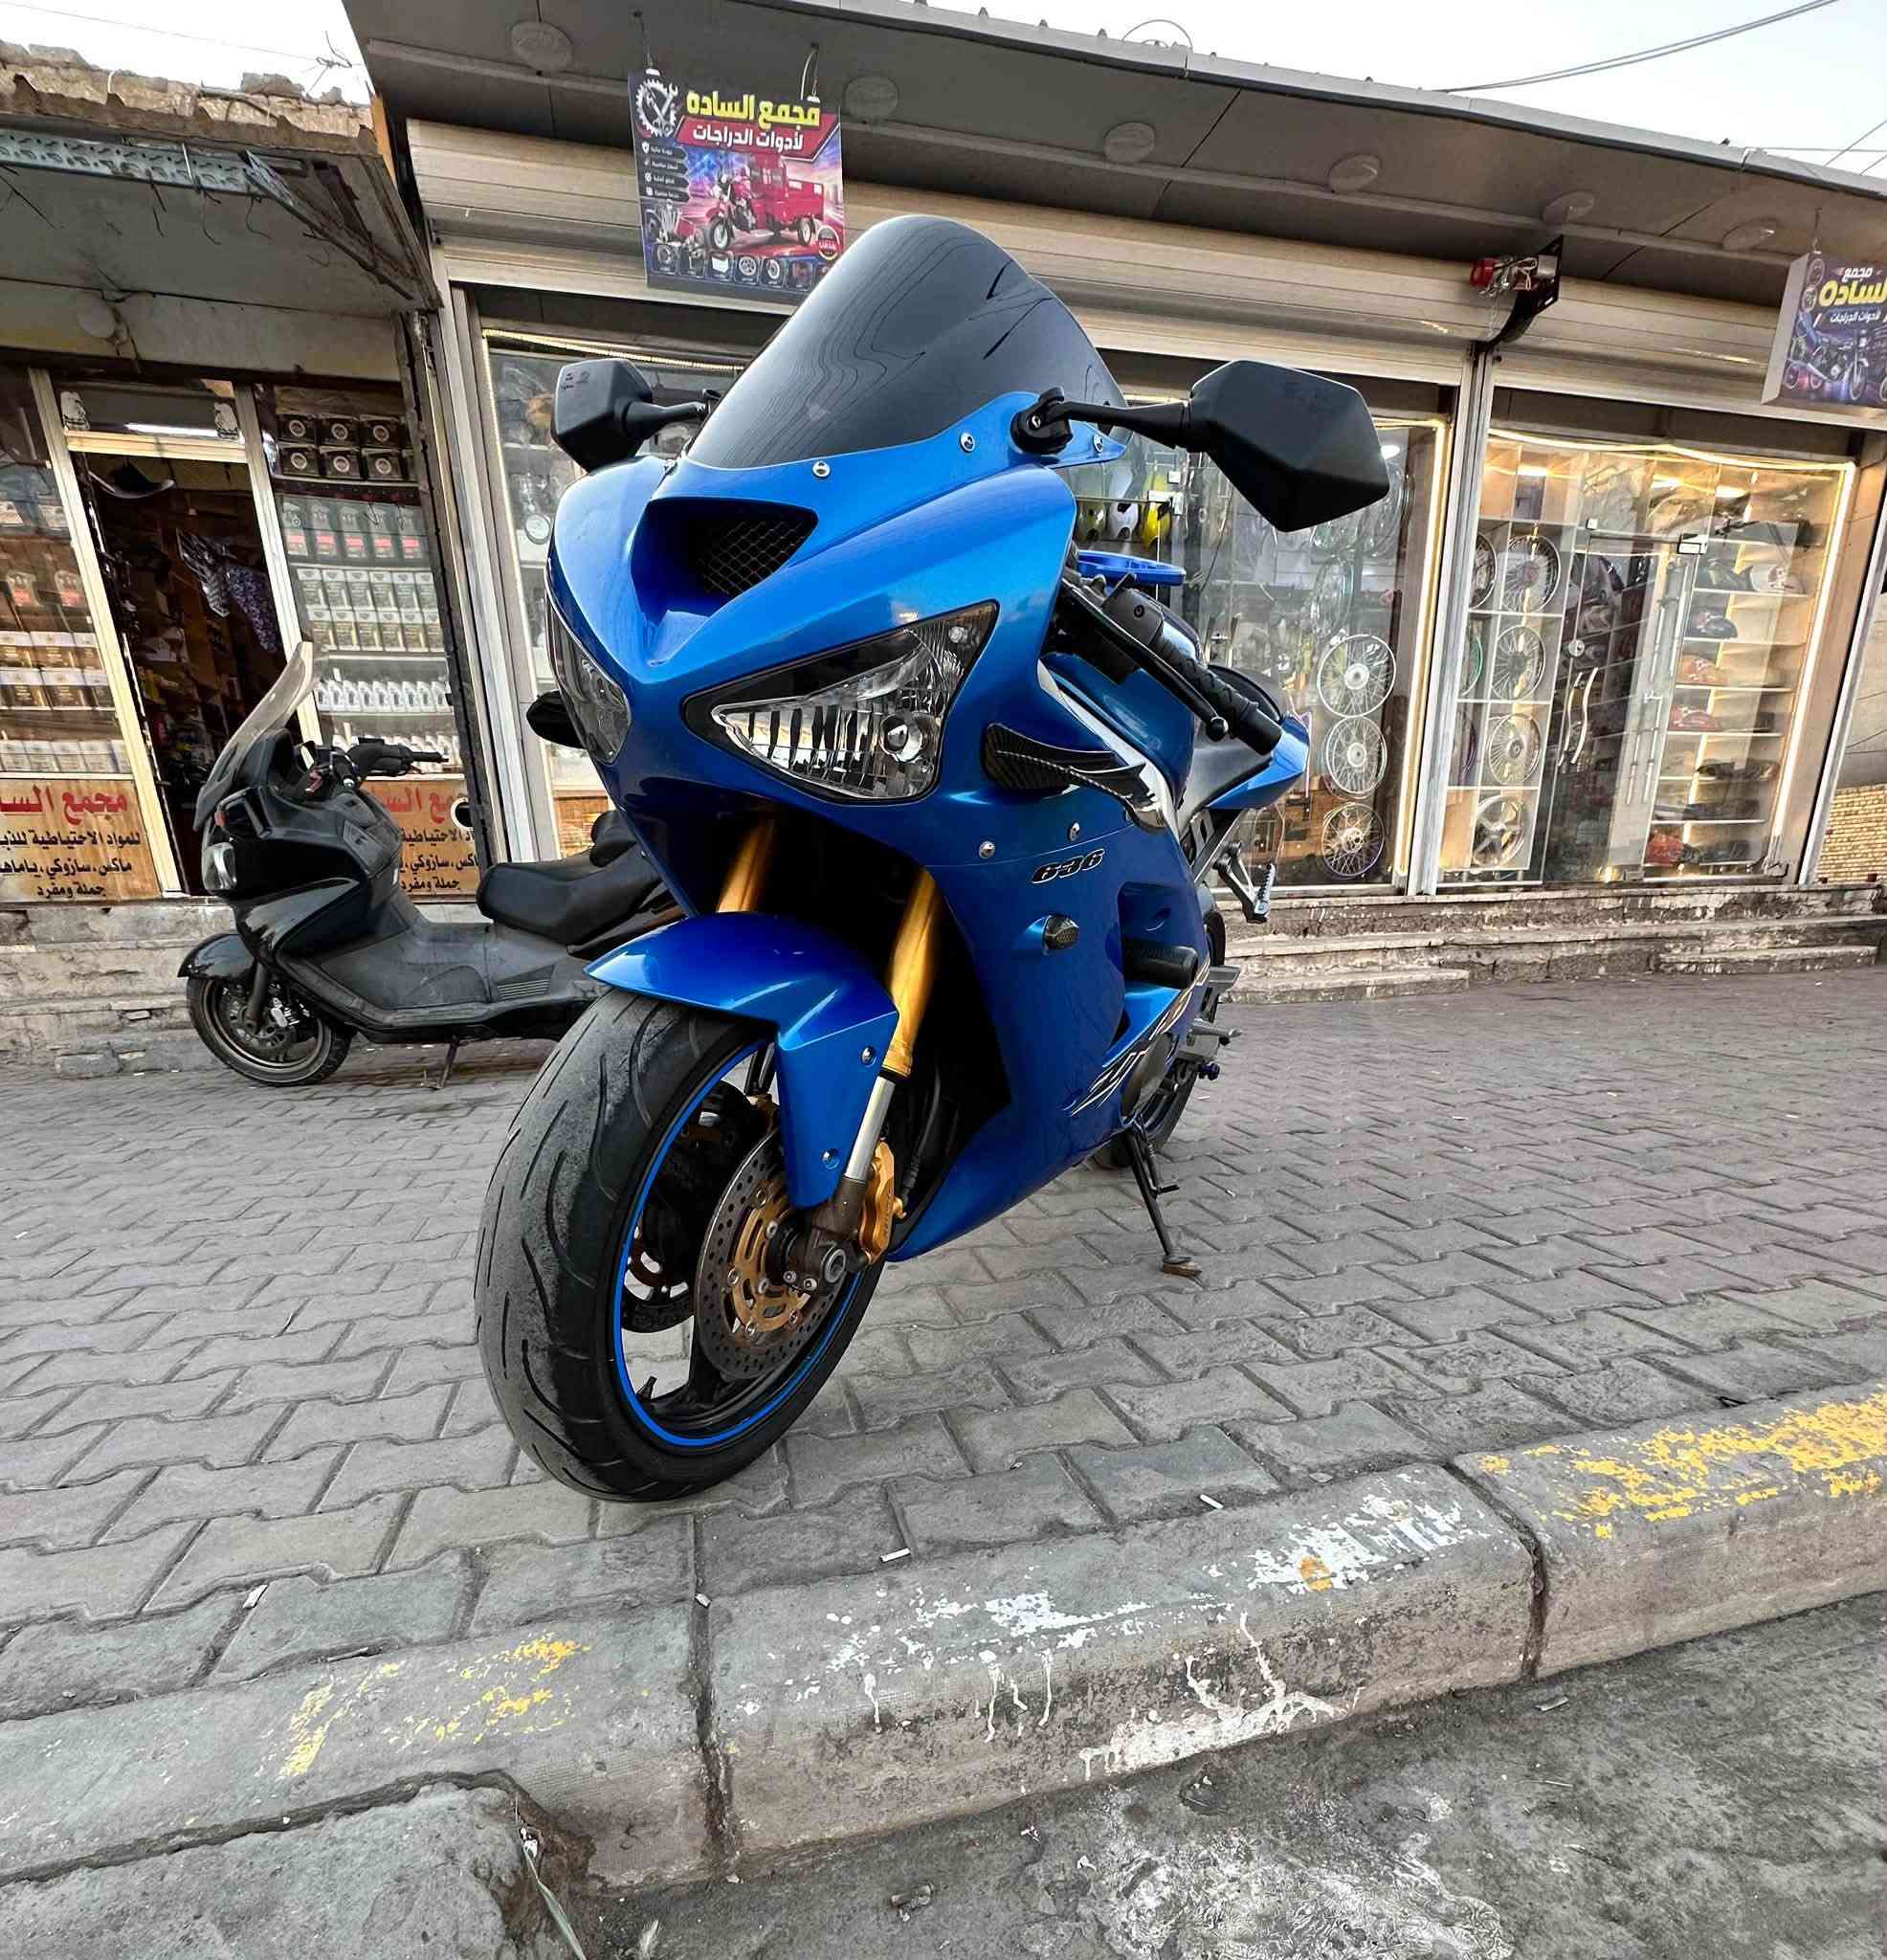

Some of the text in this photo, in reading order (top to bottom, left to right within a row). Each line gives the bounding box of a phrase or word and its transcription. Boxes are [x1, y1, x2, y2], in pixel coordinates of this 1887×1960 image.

[759, 100, 820, 131] مجمع
[692, 124, 753, 146] الدراجات
[1841, 267, 1874, 283] مجمع
[1819, 278, 1887, 306] لساده
[0, 784, 128, 825] مجمع الس
[28, 829, 103, 850] الاحتياطية
[107, 831, 142, 849] للمواد
[0, 858, 39, 878] ياماه
[1032, 848, 1105, 883] 636
[37, 880, 107, 900] جملة ومفرد
[401, 876, 460, 893] جملة ومفرد
